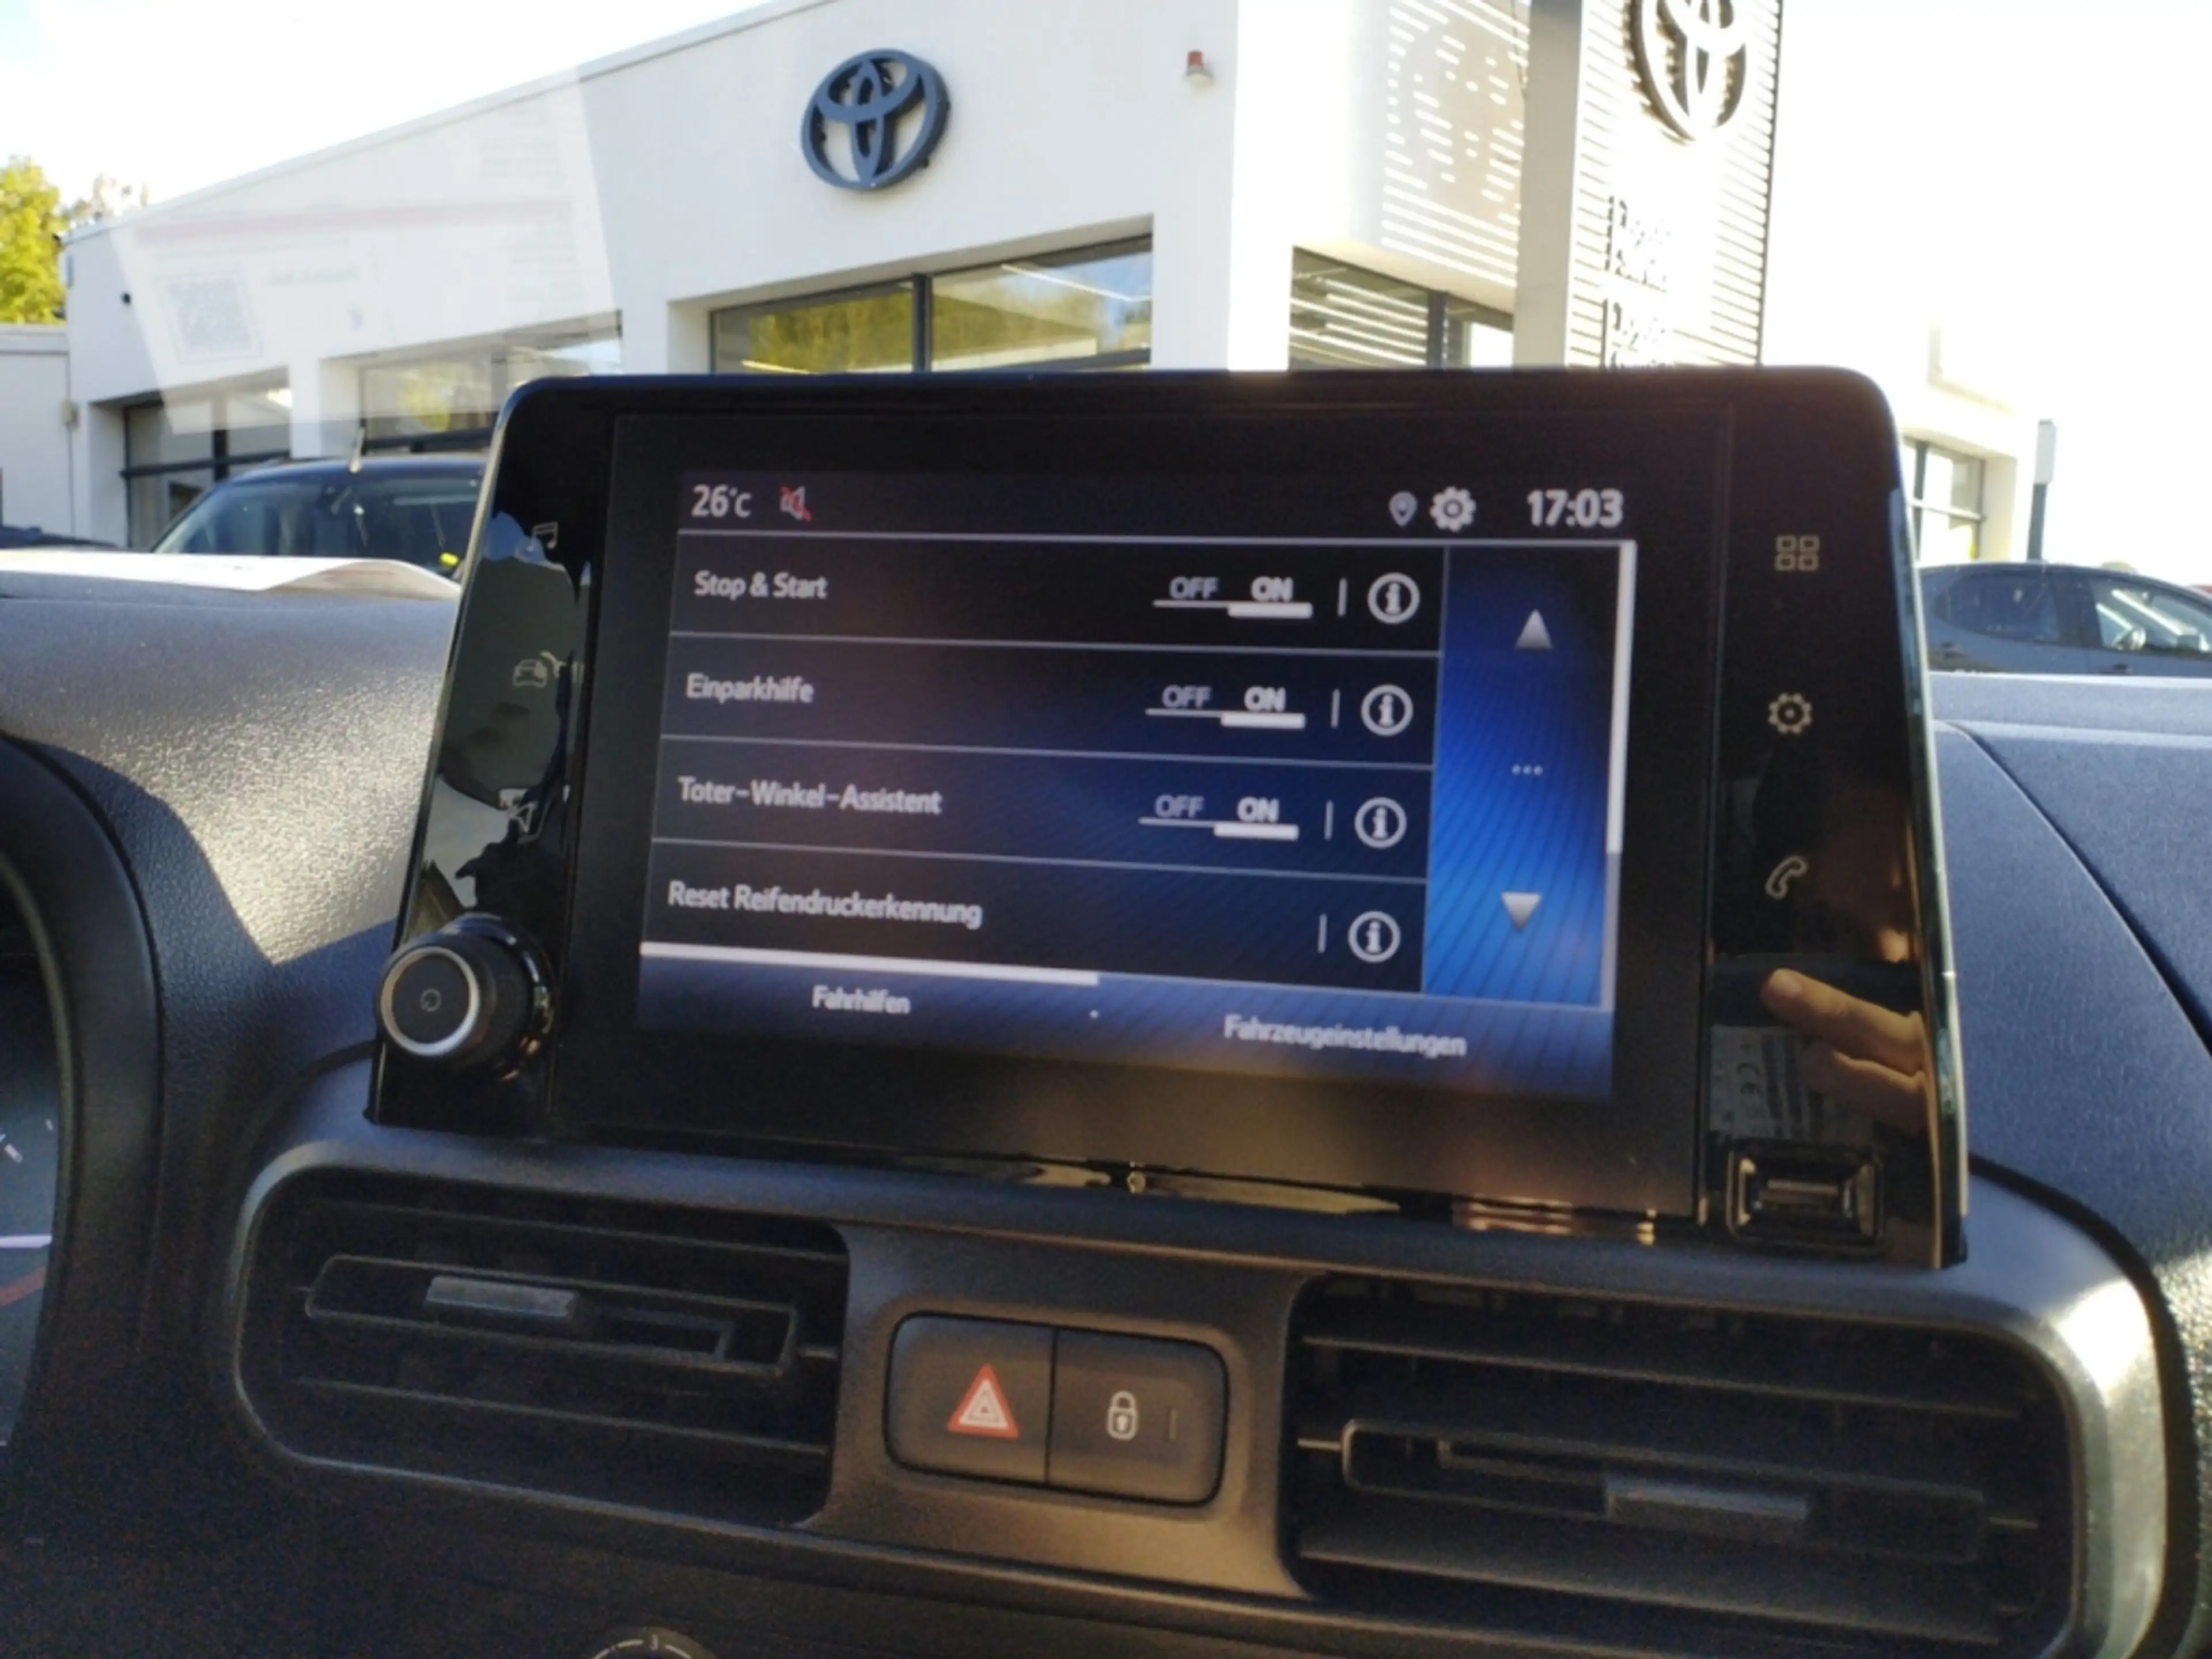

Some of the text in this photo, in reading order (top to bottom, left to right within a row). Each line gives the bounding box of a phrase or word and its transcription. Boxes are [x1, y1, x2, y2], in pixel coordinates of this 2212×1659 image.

[1527, 488, 1624, 528] 17:03
[694, 570, 828, 601] Stop & Start
[1169, 577, 1218, 599] OFF
[1250, 576, 1294, 601] ON
[685, 673, 815, 704] Einparkhilfe
[1161, 685, 1211, 709] OFF
[1244, 686, 1287, 712] ON
[678, 775, 944, 815] Toter-Winkel-Assistent
[1154, 794, 1205, 819] OFF
[1237, 797, 1280, 823] ON
[668, 880, 984, 930] Reset Reifendruckerkennung
[812, 984, 911, 1015] Fahrhilfen
[1222, 1013, 1467, 1059] Fahrzeugeinstellungen
